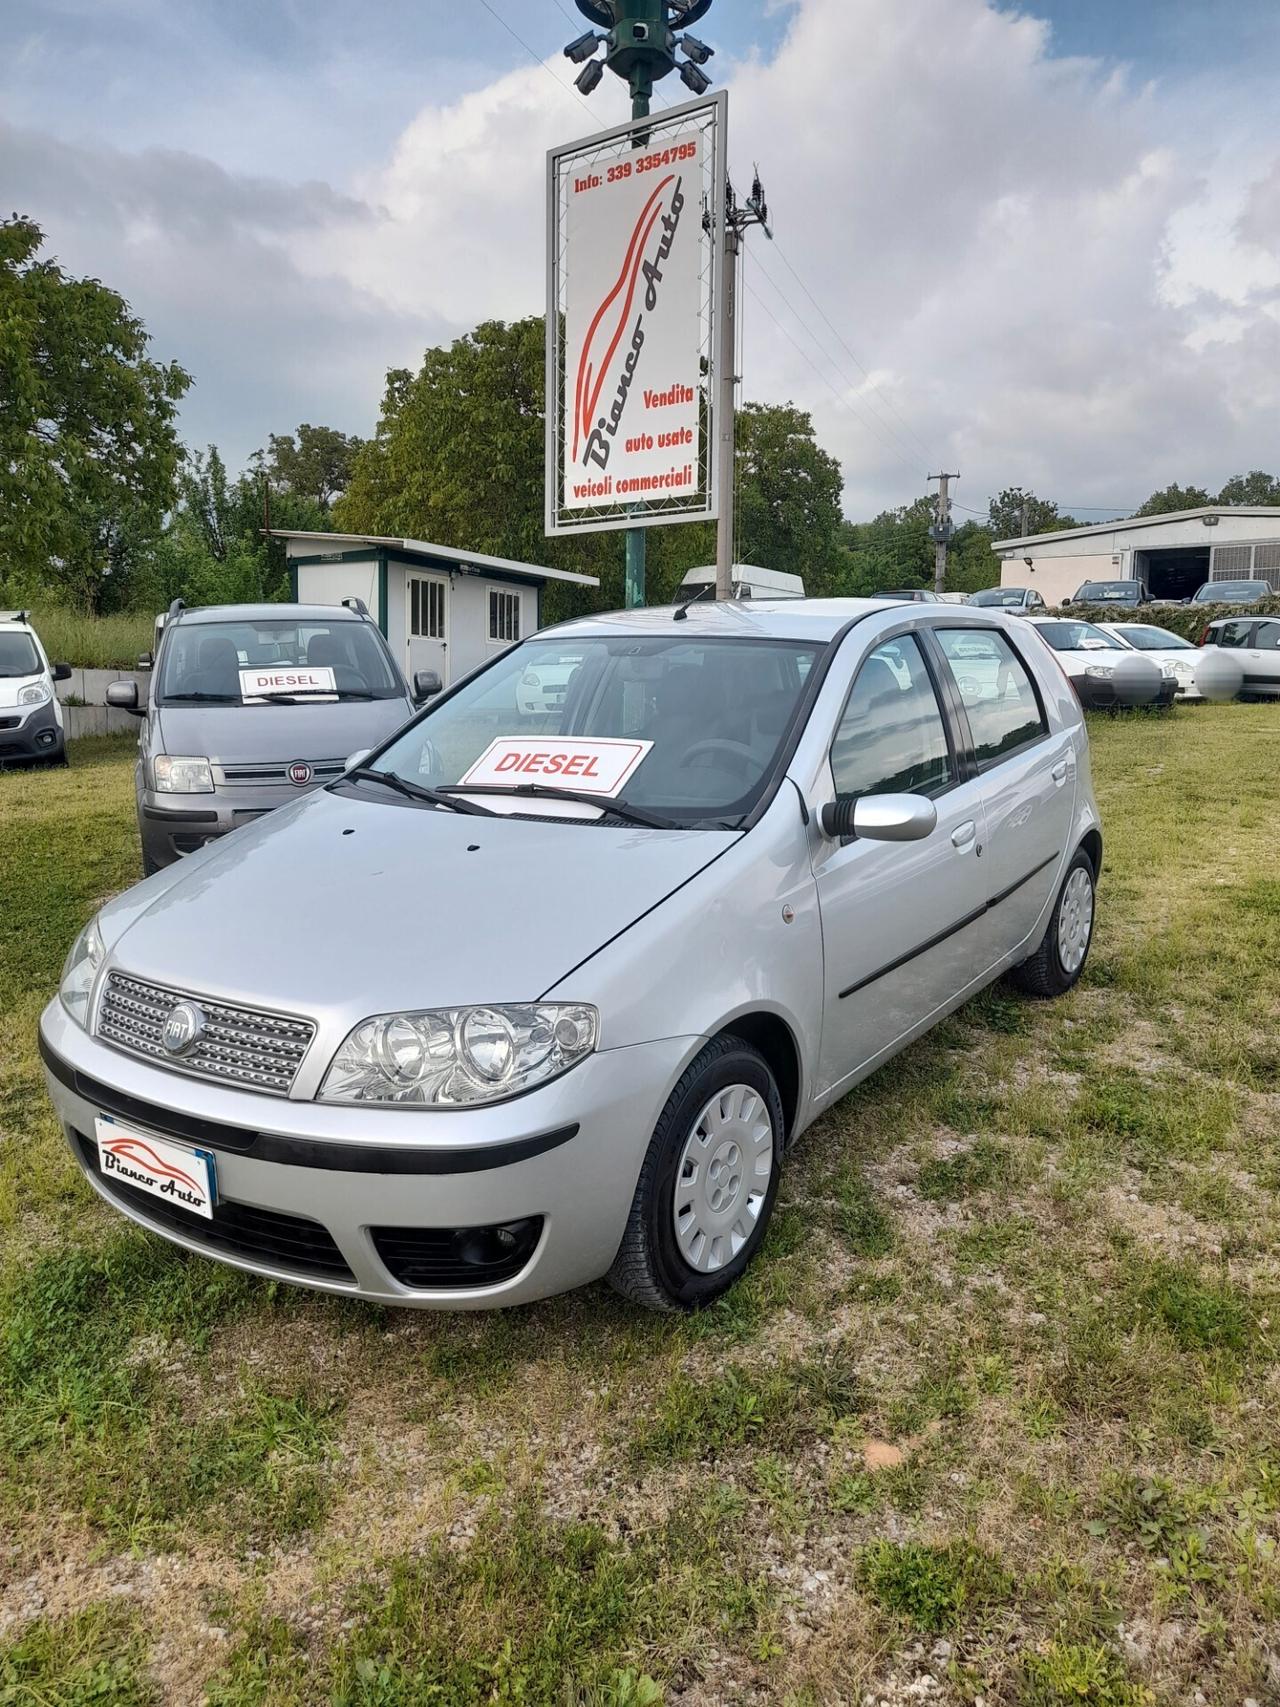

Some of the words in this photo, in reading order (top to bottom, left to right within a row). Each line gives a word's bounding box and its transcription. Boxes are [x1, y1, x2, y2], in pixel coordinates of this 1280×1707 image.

[574, 174, 603, 193] Info:
[607, 162, 632, 183] 339
[635, 141, 697, 174] 3354795
[582, 313, 645, 470] Bianco
[641, 175, 684, 312] Auto
[643, 383, 694, 409] Vendita
[625, 433, 654, 453] auto
[657, 426, 693, 448] usate
[573, 475, 612, 498] veicoli
[615, 464, 692, 494] commerciali
[256, 675, 319, 687] DIESEL
[494, 753, 599, 777] DIESEL
[164, 1019, 188, 1039] FIAT
[102, 1149, 158, 1187] Bianco
[160, 1180, 206, 1207] Auto
